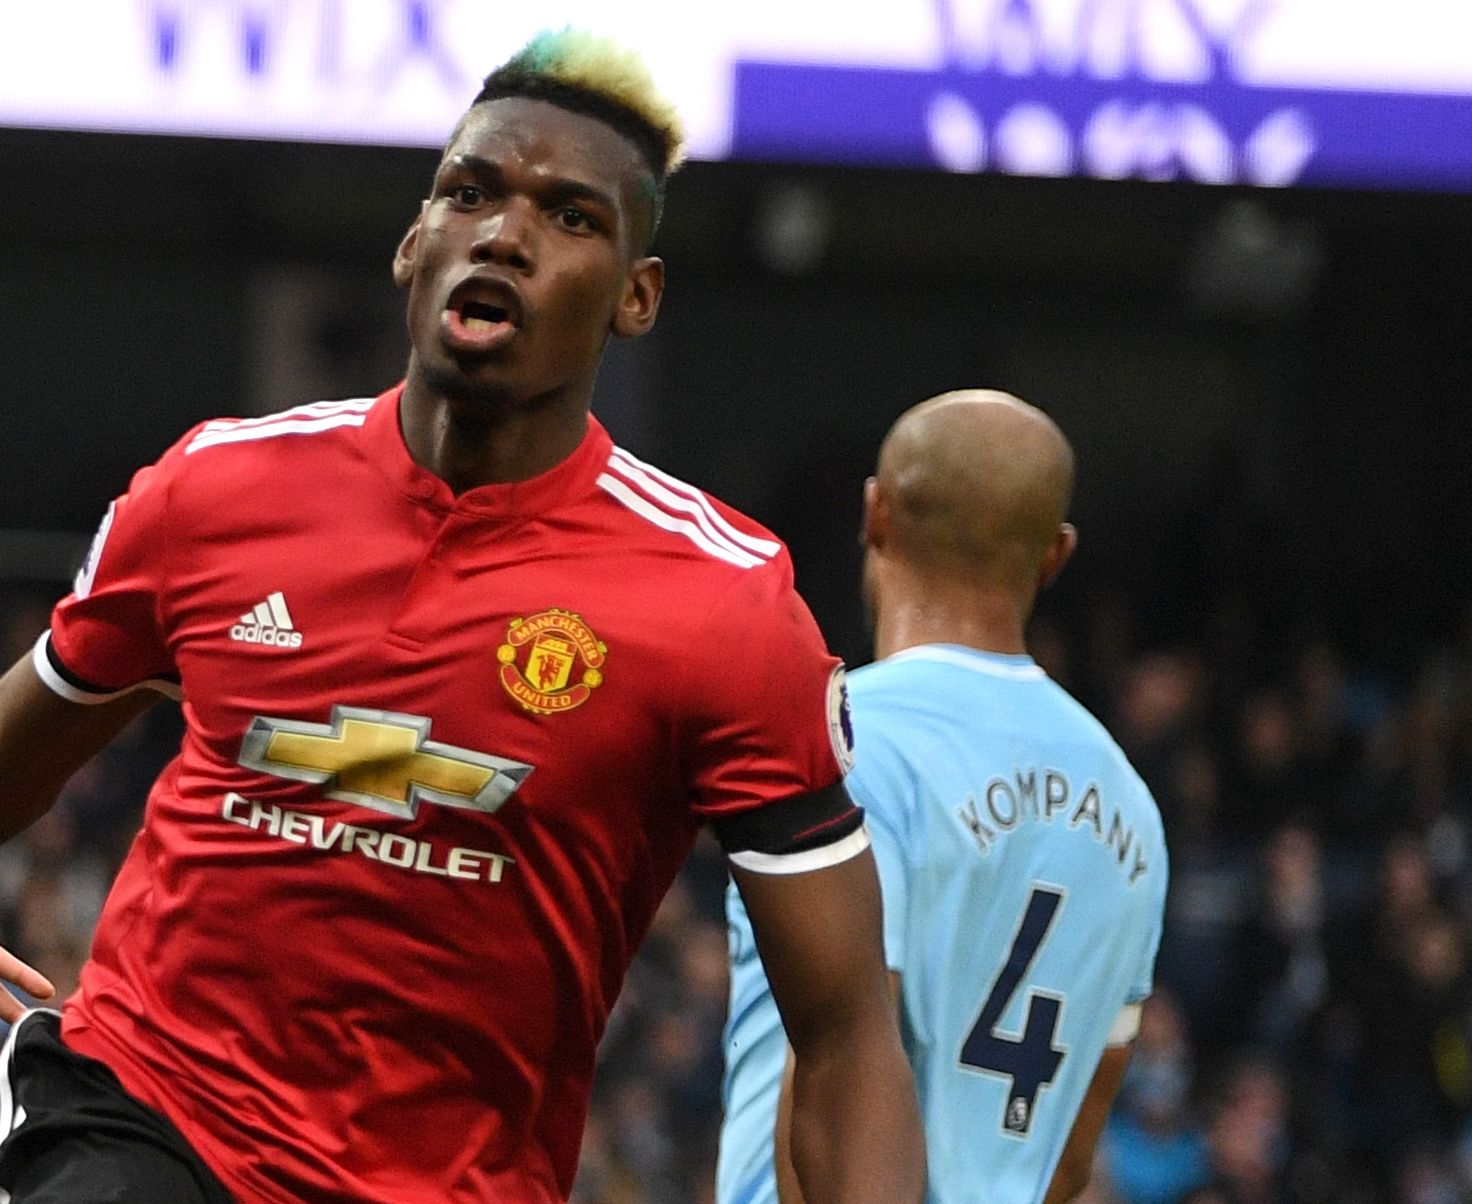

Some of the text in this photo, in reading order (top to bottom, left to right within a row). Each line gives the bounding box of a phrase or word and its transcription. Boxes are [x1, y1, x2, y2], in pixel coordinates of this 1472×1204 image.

[230, 622, 303, 648] adidas
[515, 615, 597, 660] MANCHESTER
[513, 681, 571, 707] UNITED
[222, 792, 516, 883] CHEVROLET
[958, 766, 1148, 886] KOMPANY
[958, 880, 1068, 1141] 4
